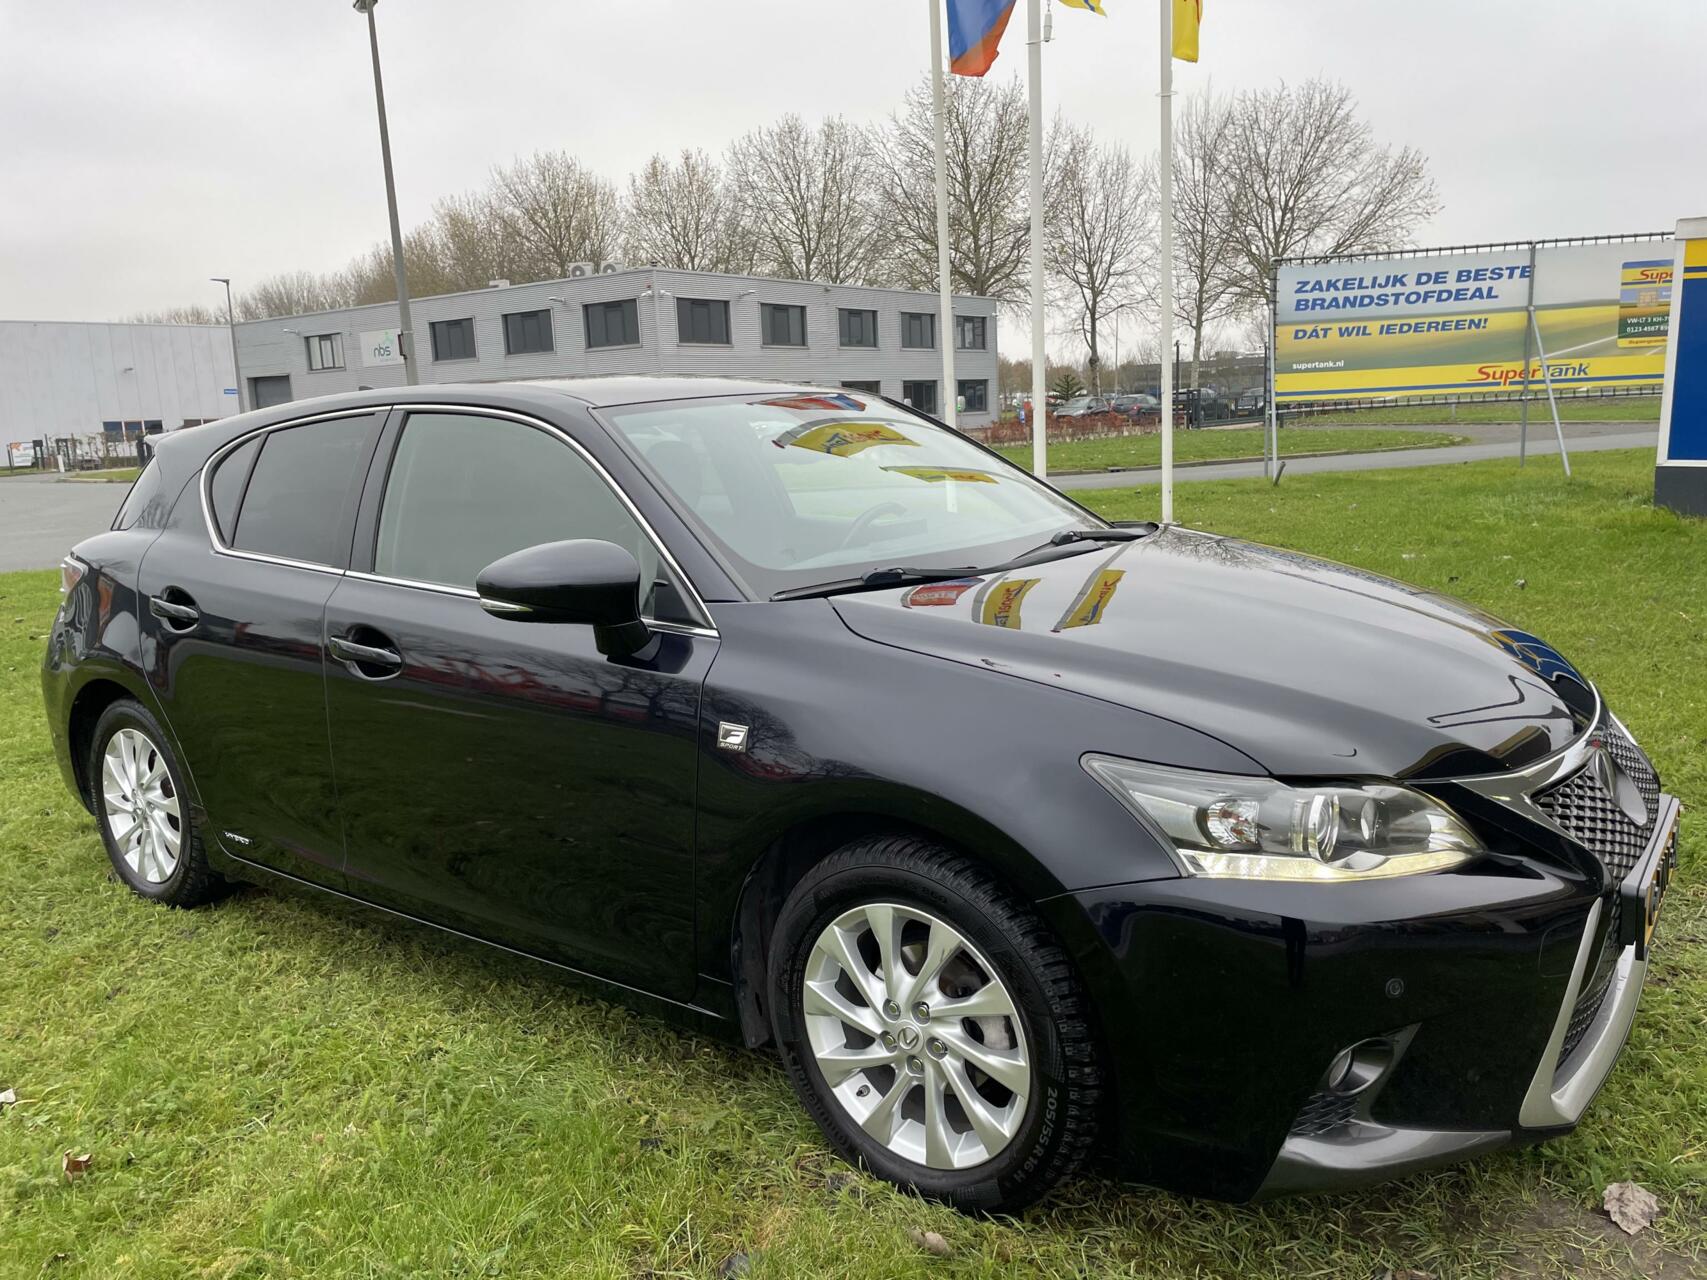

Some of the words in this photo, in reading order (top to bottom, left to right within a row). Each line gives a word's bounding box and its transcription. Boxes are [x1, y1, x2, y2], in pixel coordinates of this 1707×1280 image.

[1294, 273, 1408, 294] ZAKELIJK
[1415, 270, 1449, 286] DE
[1456, 264, 1534, 283] BESTE
[1294, 287, 1499, 312] BRANDSTOFDEAL
[1293, 325, 1332, 340] DÁT
[1338, 325, 1372, 337] WIL
[1379, 318, 1488, 335] IEDEREEN!
[373, 343, 391, 358] nbs
[1292, 360, 1345, 370] supertank.nl
[720, 742, 743, 751] SPORT
[1037, 1086, 1057, 1147] 205/55
